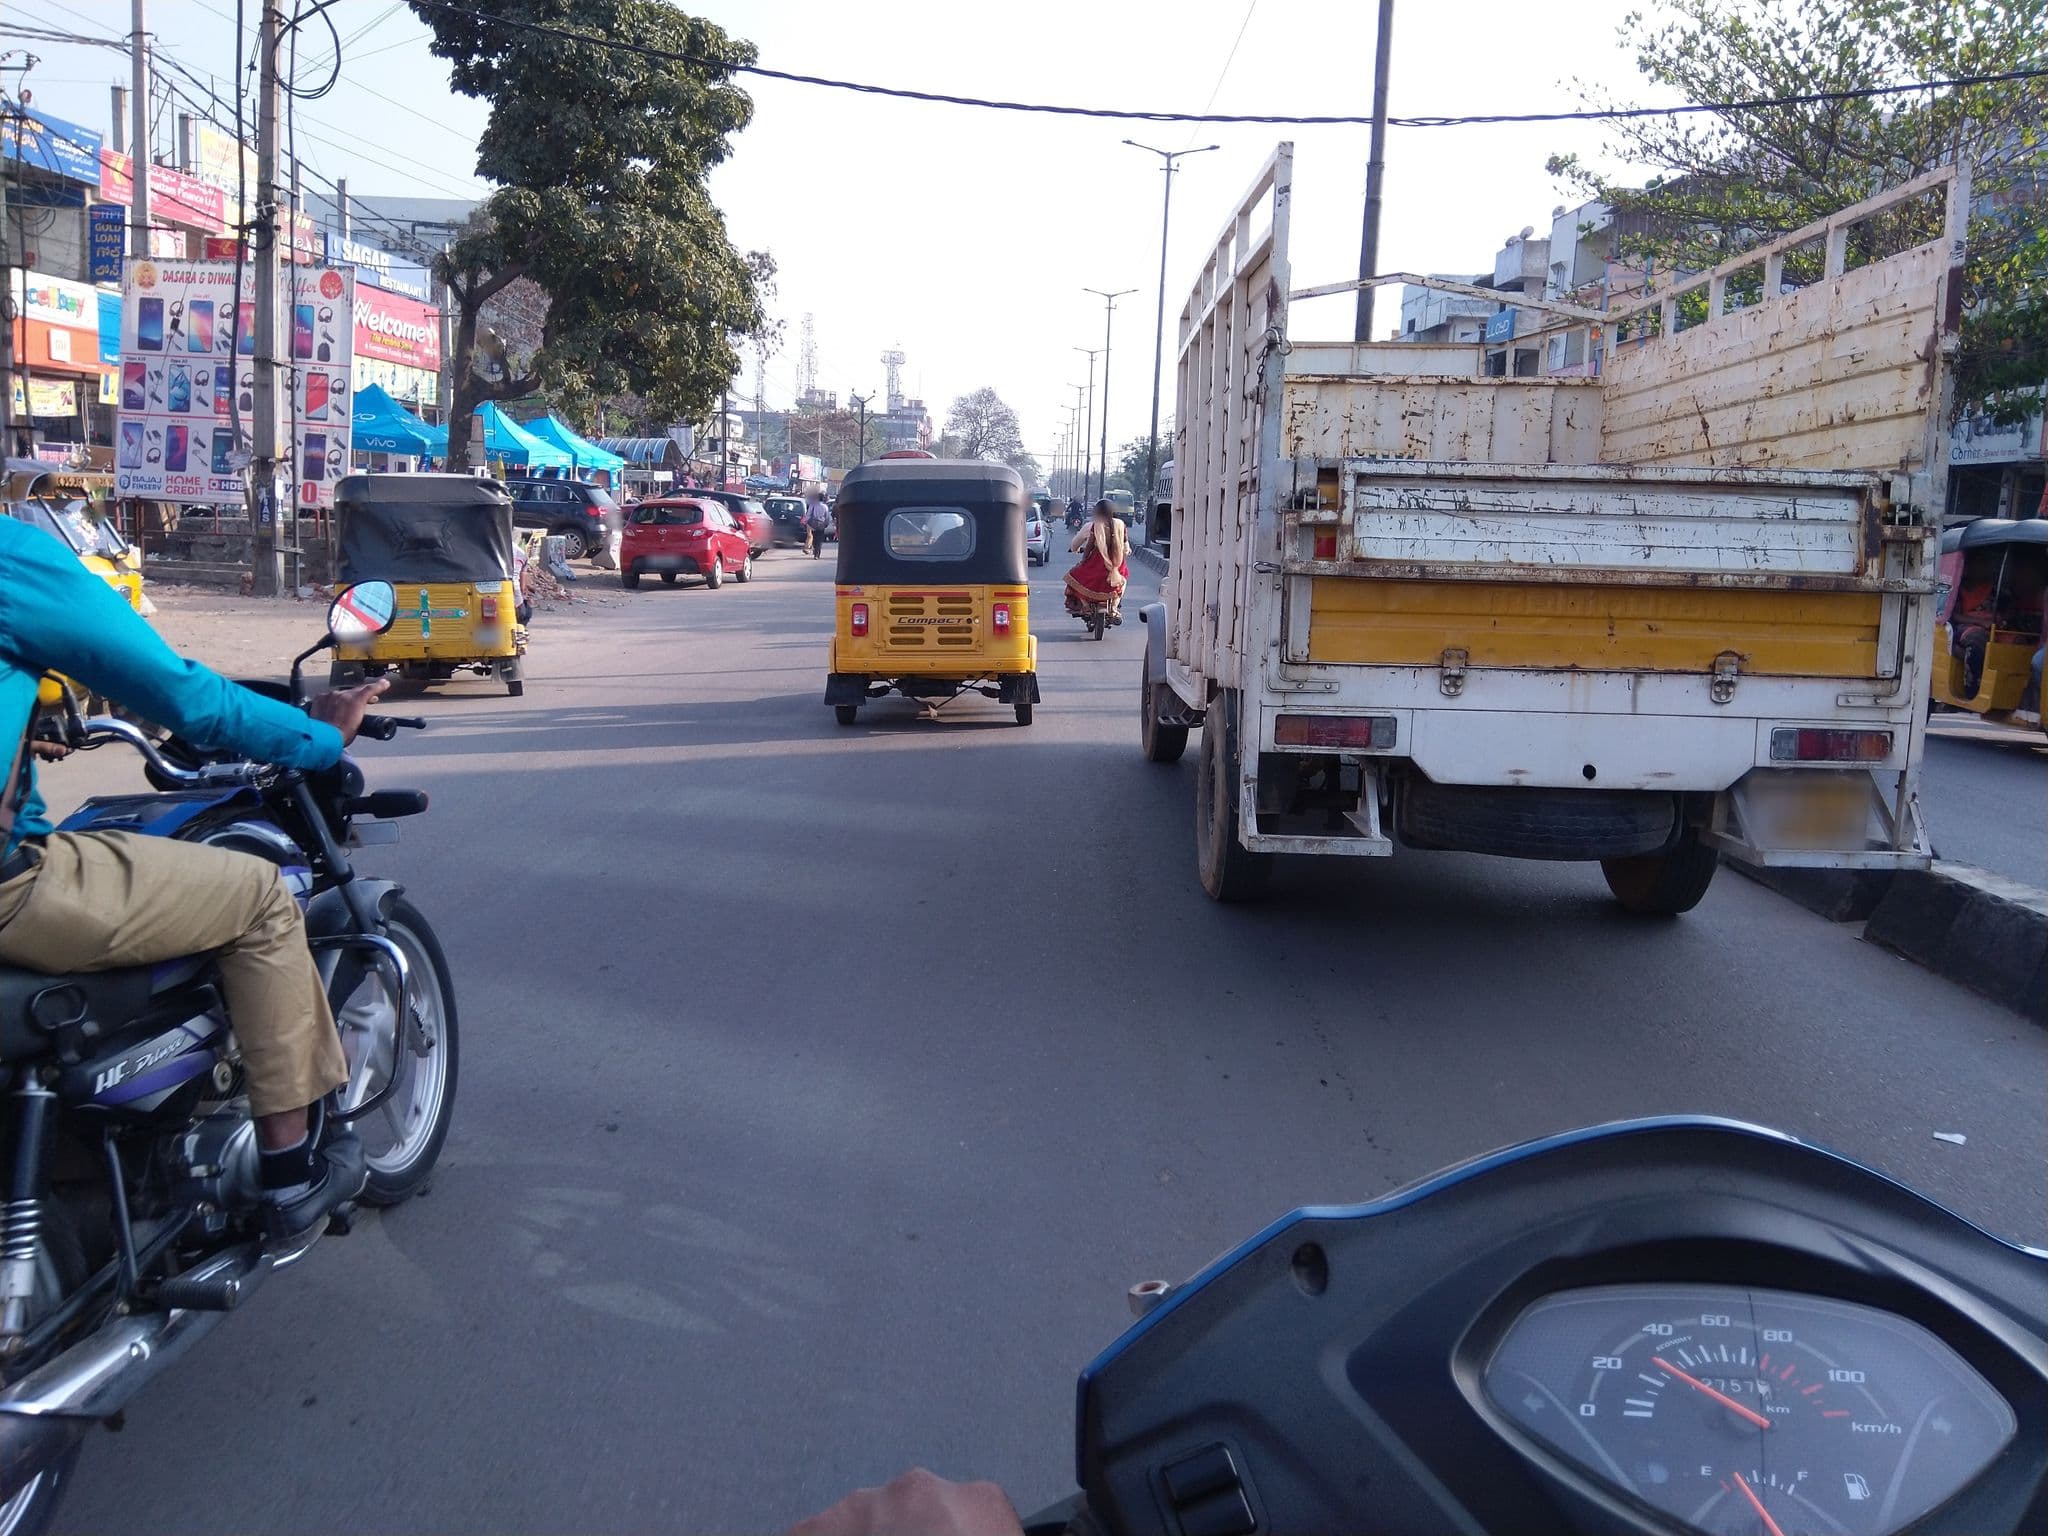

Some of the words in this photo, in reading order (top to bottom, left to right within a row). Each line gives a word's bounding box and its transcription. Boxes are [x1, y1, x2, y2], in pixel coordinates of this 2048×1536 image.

[95, 222, 121, 232] GOLD
[95, 233, 120, 243] LOAN
[342, 240, 390, 276] SAGAR
[162, 270, 197, 284] DASARA
[379, 275, 423, 299] RESTAURANT
[354, 299, 426, 343] Welcome
[365, 438, 396, 448] vivo
[132, 475, 162, 483] BAJAJ
[166, 475, 201, 486] HOME
[132, 483, 162, 491] FINSERV
[165, 485, 205, 496] CREDIT
[897, 616, 963, 625] Compact
[94, 1060, 130, 1095] HF
[1701, 1314, 1731, 1327] 60
[1642, 1323, 1673, 1336] 40
[1763, 1329, 1793, 1342] 80
[1592, 1356, 1622, 1369] 20
[1827, 1369, 1865, 1383] 100
[1580, 1404, 1595, 1417] 0
[1766, 1403, 1790, 1414] km
[1851, 1421, 1902, 1434] km/h
[1700, 1465, 1712, 1476] E
[1797, 1471, 1808, 1481] F
